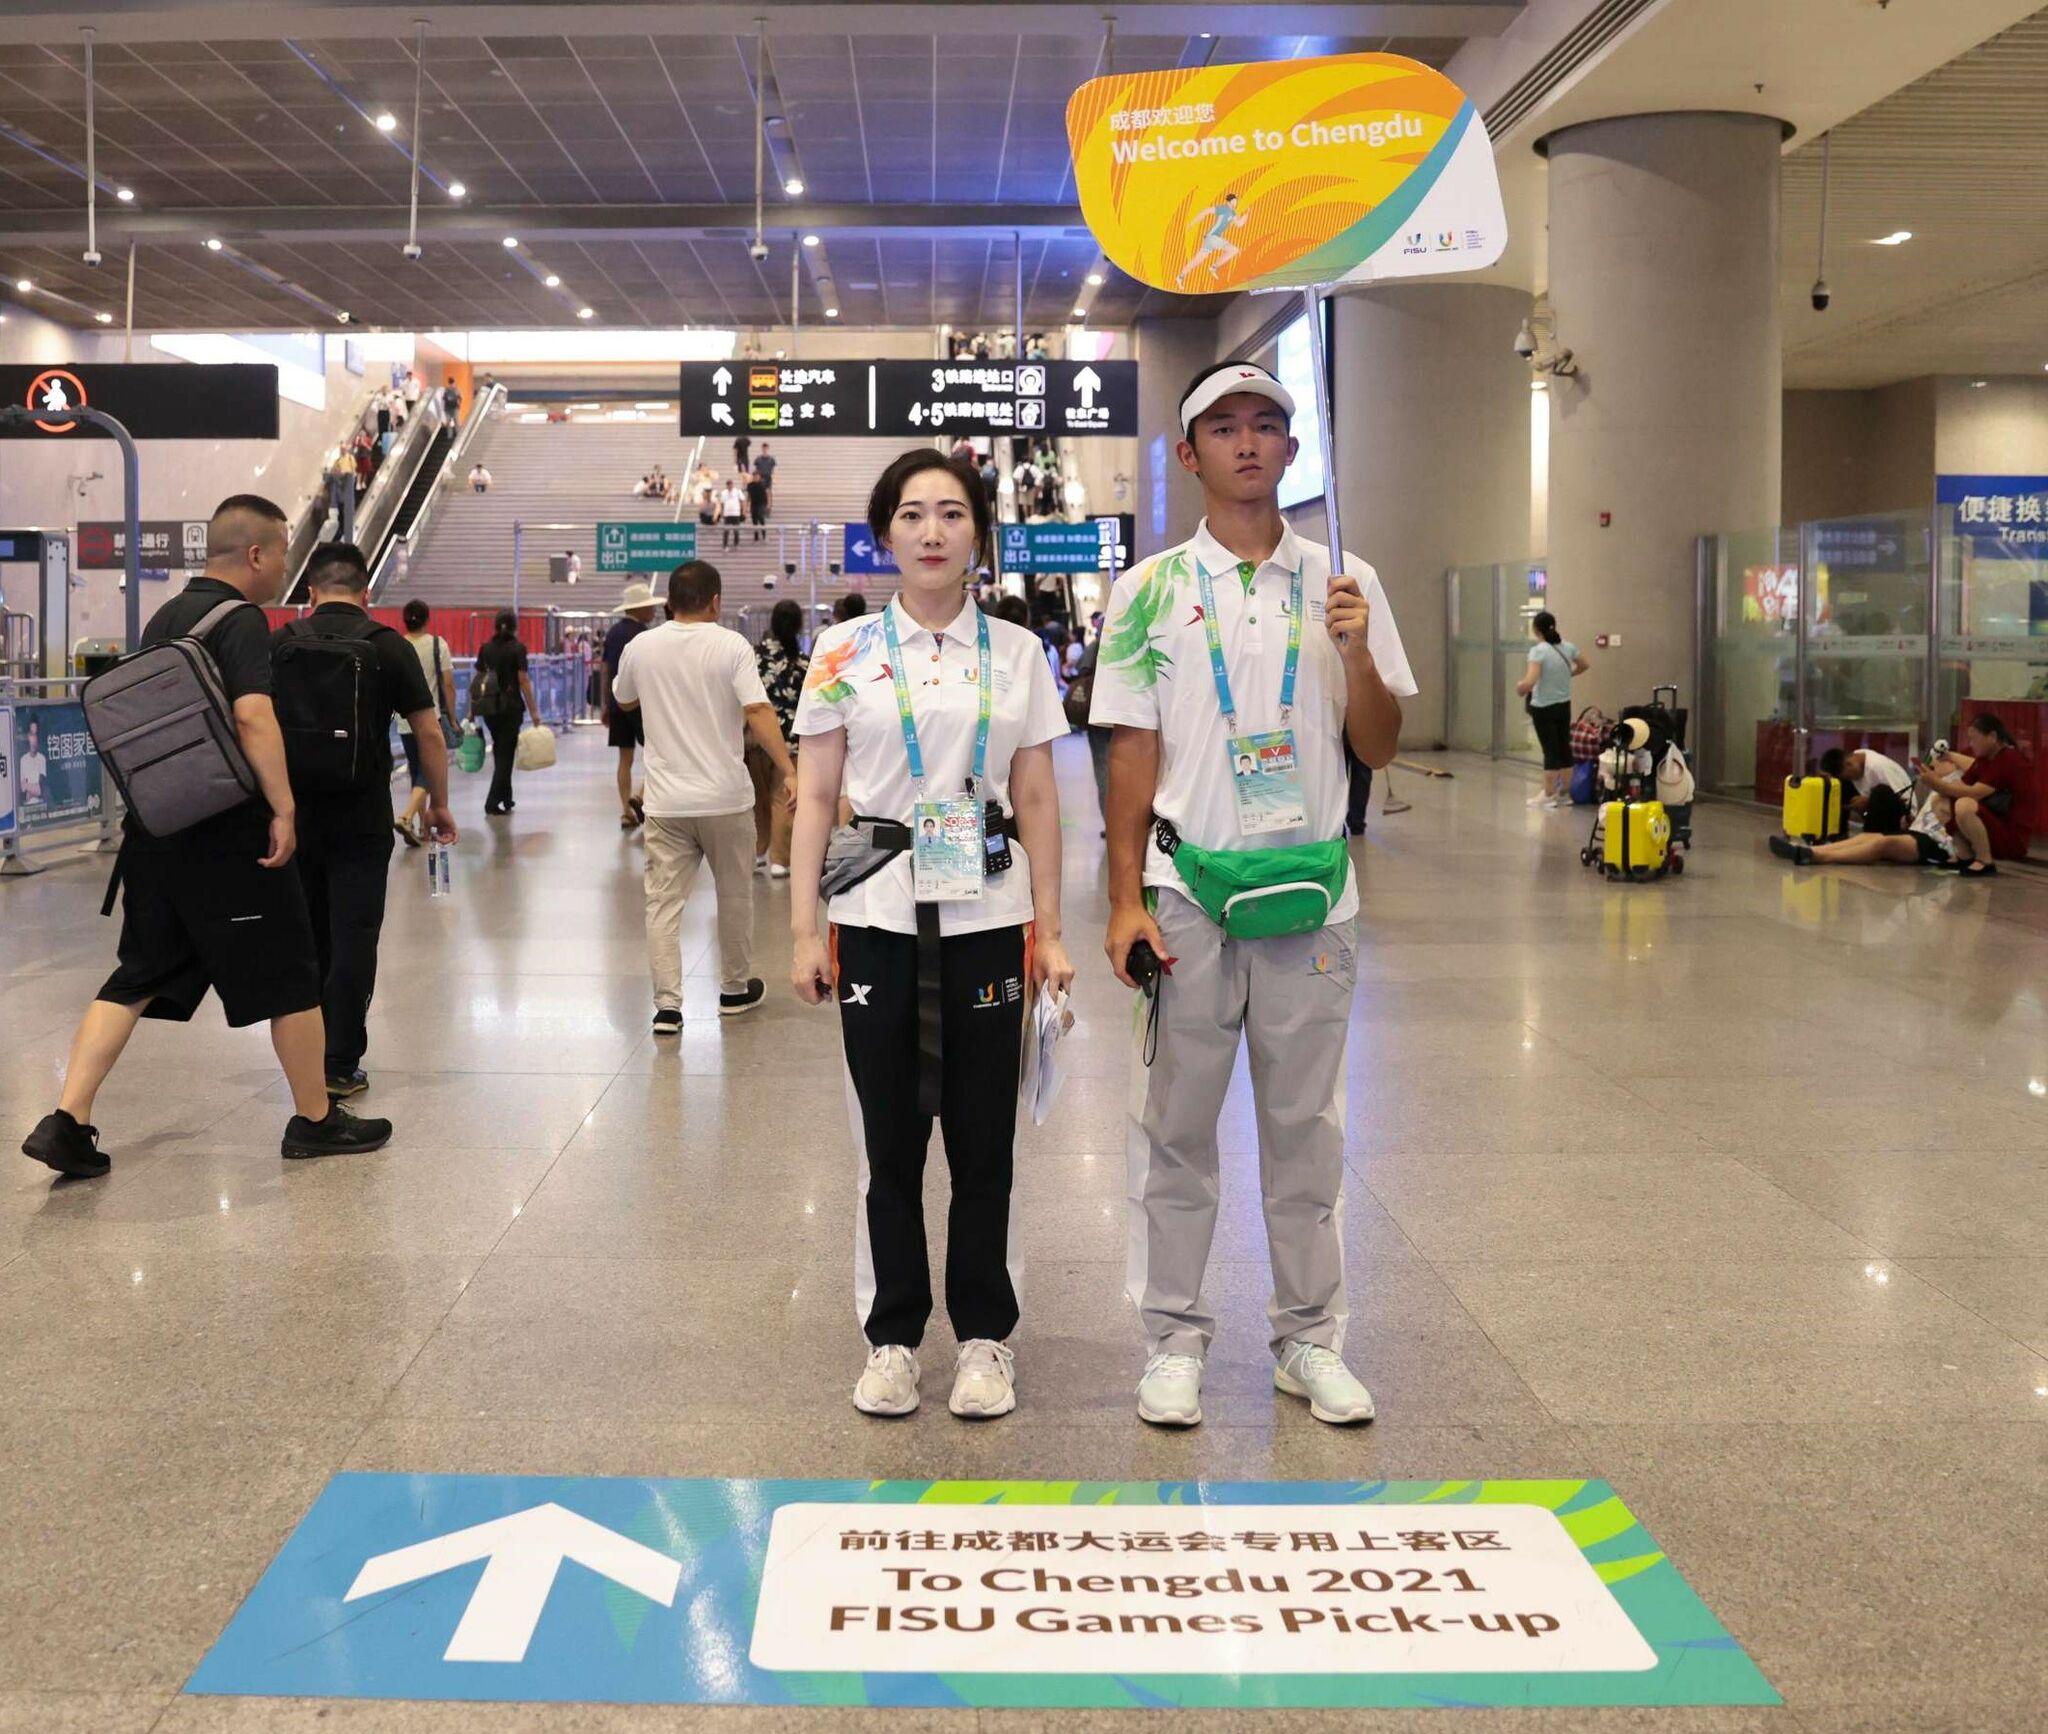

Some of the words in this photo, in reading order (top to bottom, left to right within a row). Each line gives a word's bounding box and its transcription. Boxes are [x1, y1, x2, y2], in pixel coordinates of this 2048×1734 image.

[1110, 103, 1216, 131] 成都欢迎您
[1112, 134, 1246, 164] Welcome
[1253, 128, 1284, 151] to
[1291, 112, 1423, 147] Chengdu
[1403, 247, 1427, 255] FISU
[1958, 494, 2048, 523] 便捷换
[113, 533, 169, 549] 禁通行
[602, 551, 628, 564] 出口
[1004, 549, 1031, 563] 出口
[839, 1529, 1511, 1552] 前往成都大运会专用上客区
[882, 1567, 962, 1592] To
[980, 1567, 1290, 1598] Chengdu
[1307, 1567, 1486, 1592] 2021
[830, 1606, 995, 1632] FISU
[1016, 1607, 1264, 1633] Games
[1279, 1606, 1561, 1637] Pick-up
